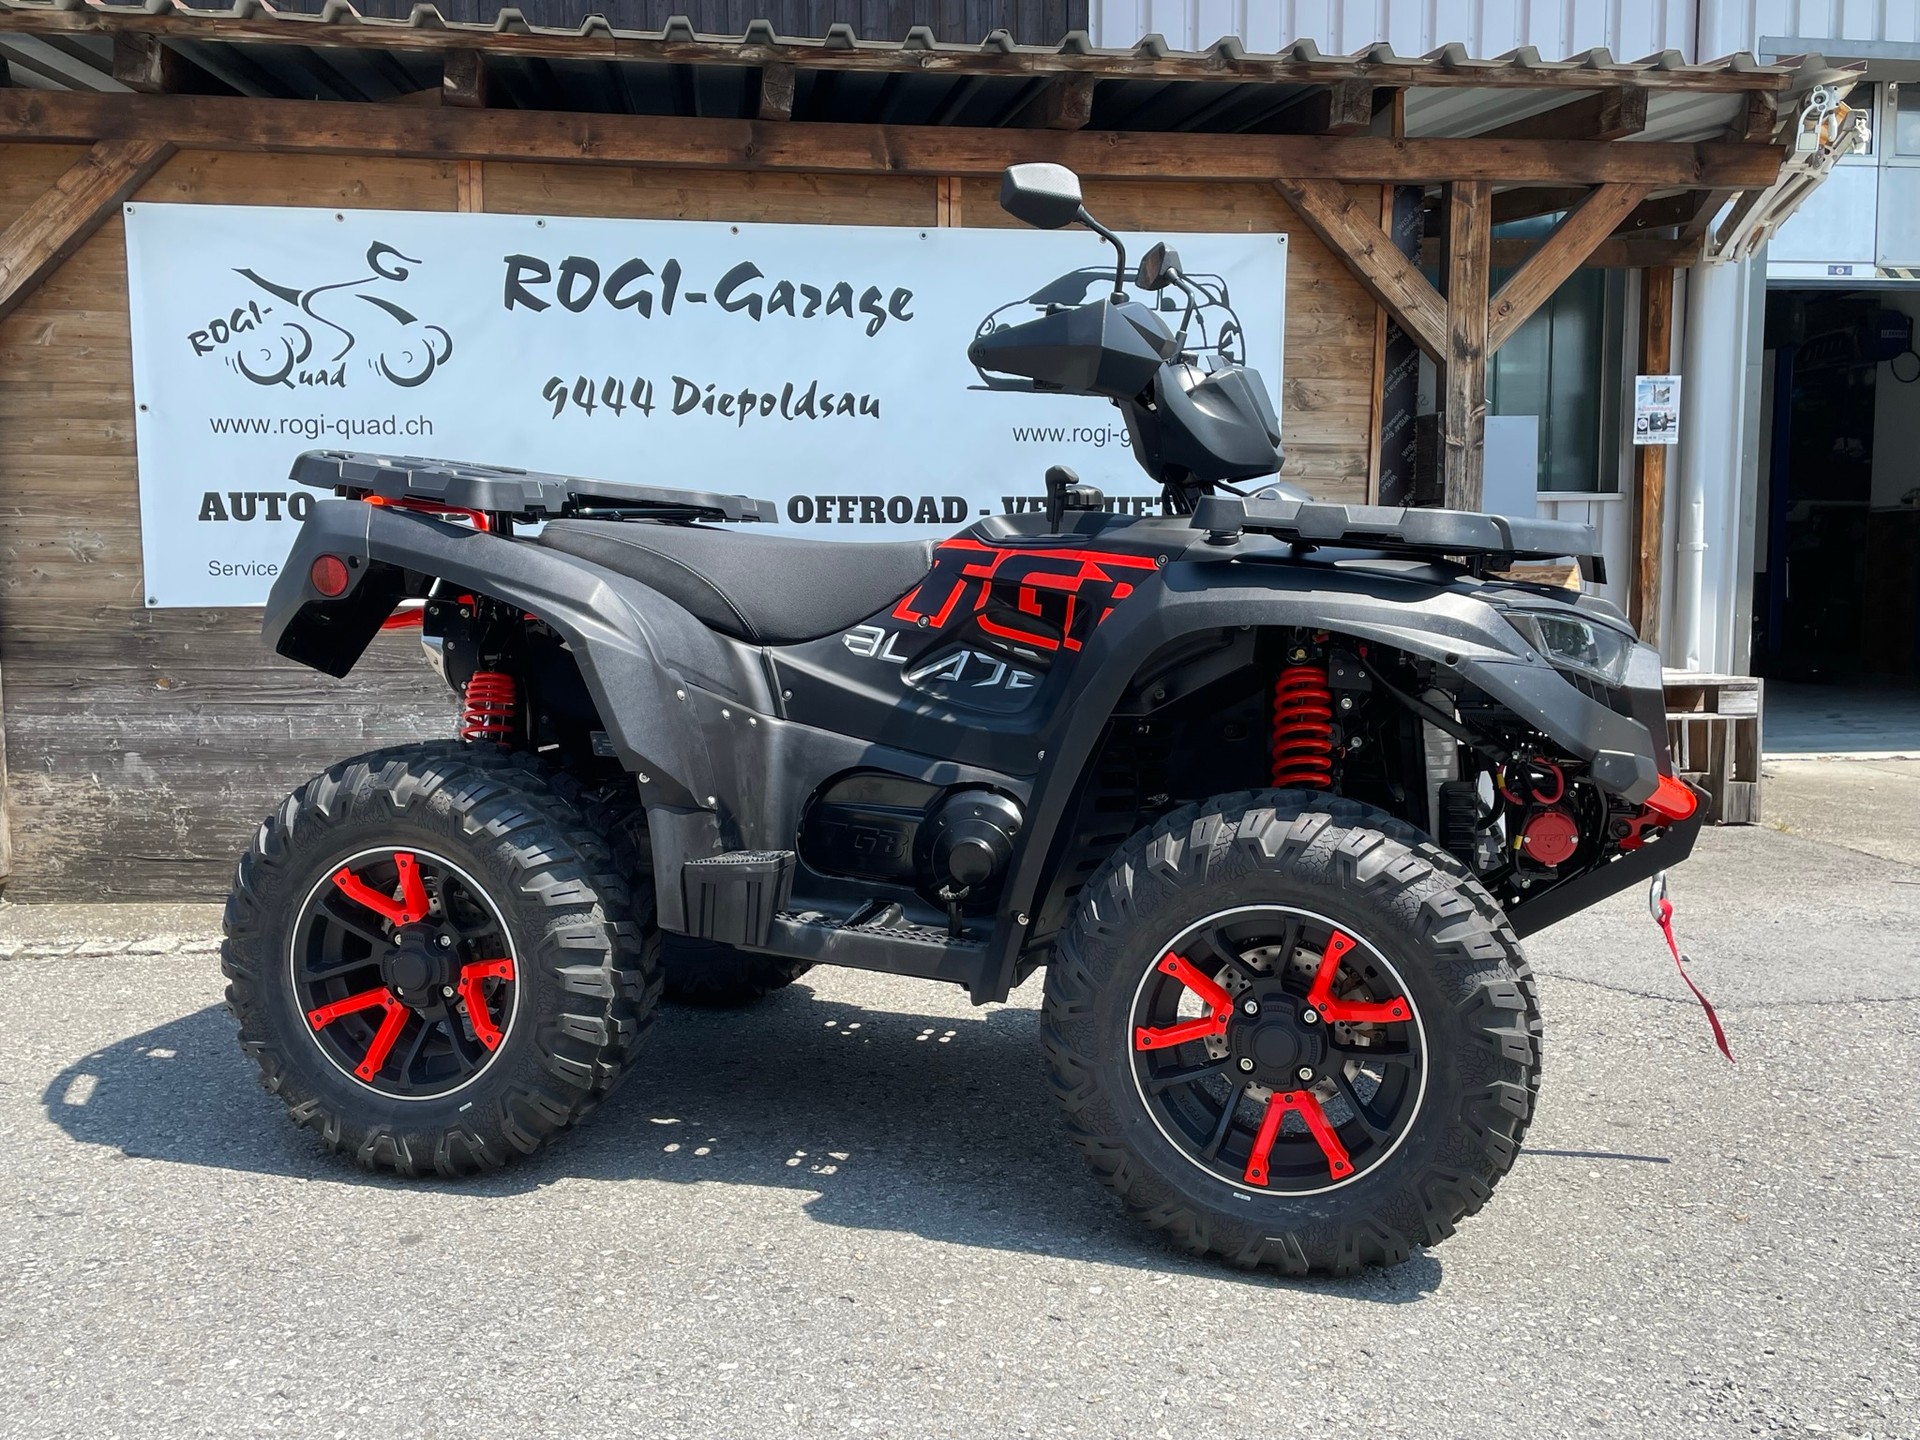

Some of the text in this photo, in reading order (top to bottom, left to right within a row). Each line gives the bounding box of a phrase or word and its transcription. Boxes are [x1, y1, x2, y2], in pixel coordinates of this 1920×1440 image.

[503, 254, 914, 338] ROGI-Garage
[187, 300, 273, 357] ROGI-
[542, 375, 880, 428] 9444 Diepoldsau
[210, 414, 433, 440] www.rogi-quad.ch
[198, 491, 316, 522] AUTO
[787, 495, 968, 524] OFFROAD
[208, 560, 278, 576] Service
